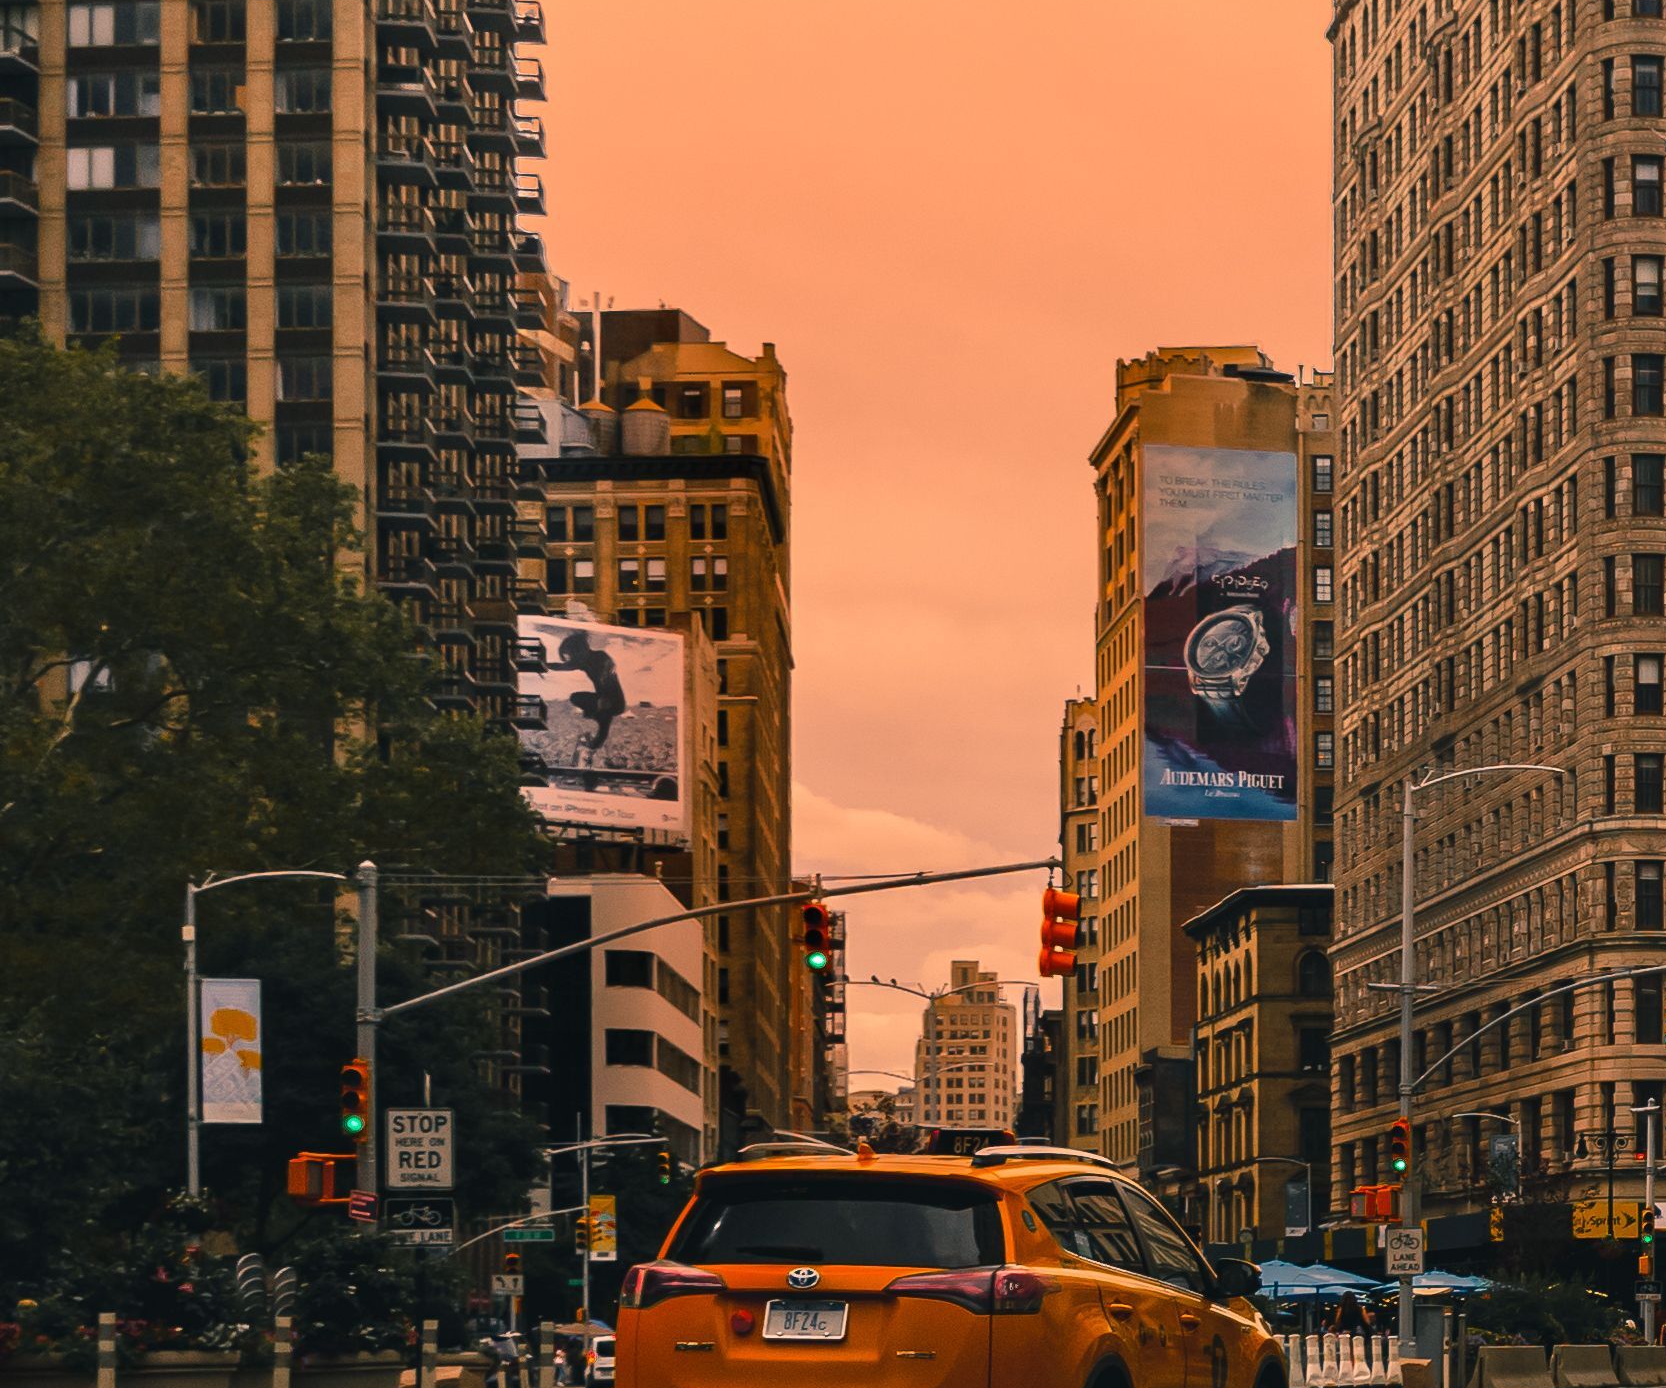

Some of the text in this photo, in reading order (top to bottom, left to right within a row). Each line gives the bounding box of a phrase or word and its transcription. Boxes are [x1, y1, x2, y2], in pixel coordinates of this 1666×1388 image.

[1160, 476, 1266, 490] TO BREAK THE RULES
[1159, 487, 1283, 503] YOU MUST FIRST MASTER
[1160, 768, 1285, 789] AUDEMARS PIGUET
[564, 804, 597, 816] iPhone
[602, 807, 616, 818] On
[617, 809, 636, 819] Tour
[393, 1115, 448, 1133] STOP
[395, 1137, 445, 1147] HERE ON
[399, 1151, 442, 1169] RED
[400, 1173, 440, 1182] SIGNAL
[1590, 1214, 1621, 1227] Sprnt
[421, 1232, 449, 1243] LANE
[1393, 1253, 1416, 1262] LANE
[1390, 1263, 1420, 1271] AHEAD
